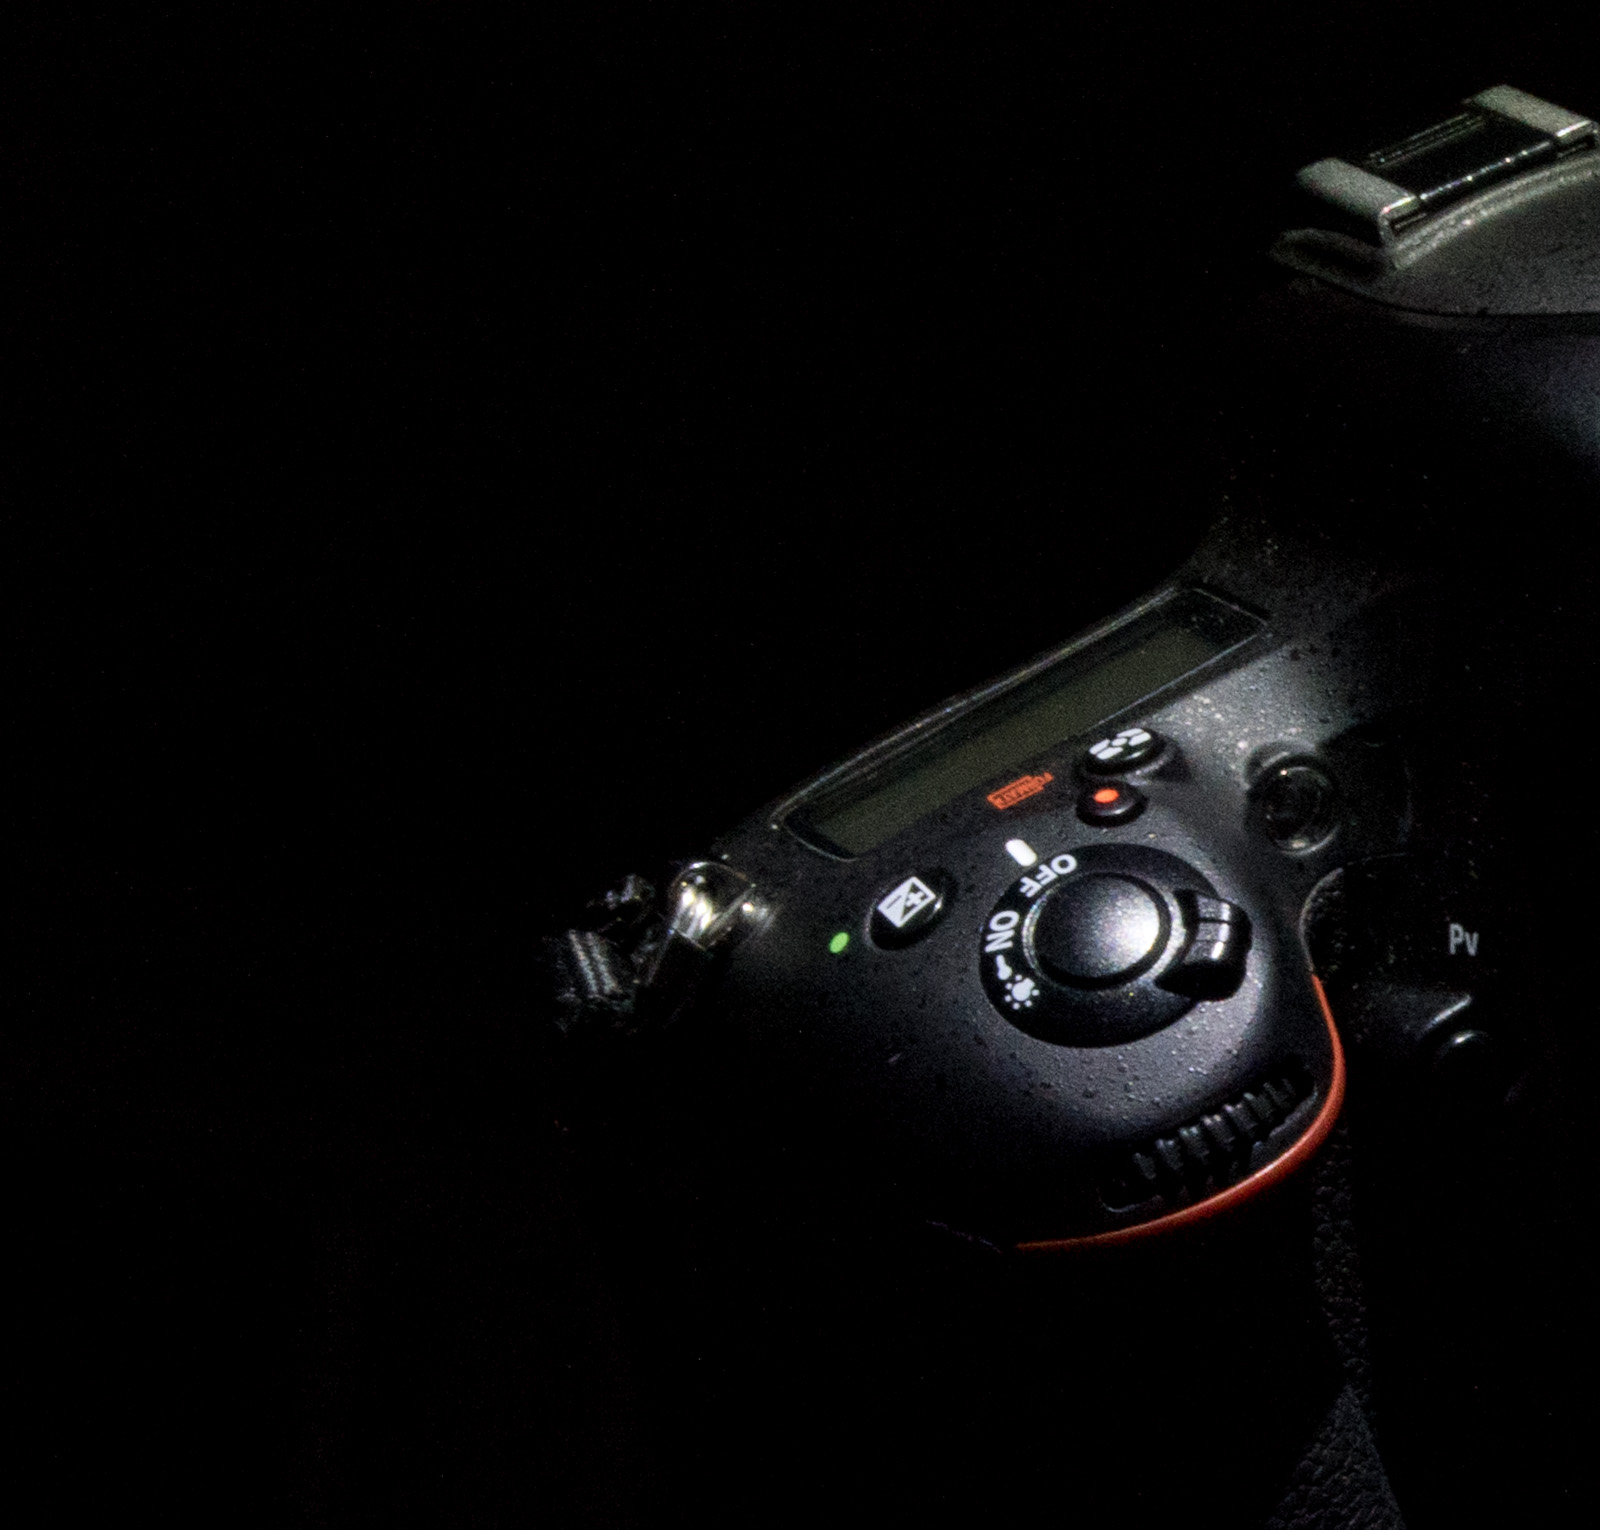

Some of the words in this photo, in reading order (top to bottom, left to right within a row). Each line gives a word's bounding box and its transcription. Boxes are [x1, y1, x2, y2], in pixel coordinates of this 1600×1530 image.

[1019, 853, 1078, 898] OFF
[984, 910, 1020, 953] ON
[1449, 923, 1479, 956] Pv
